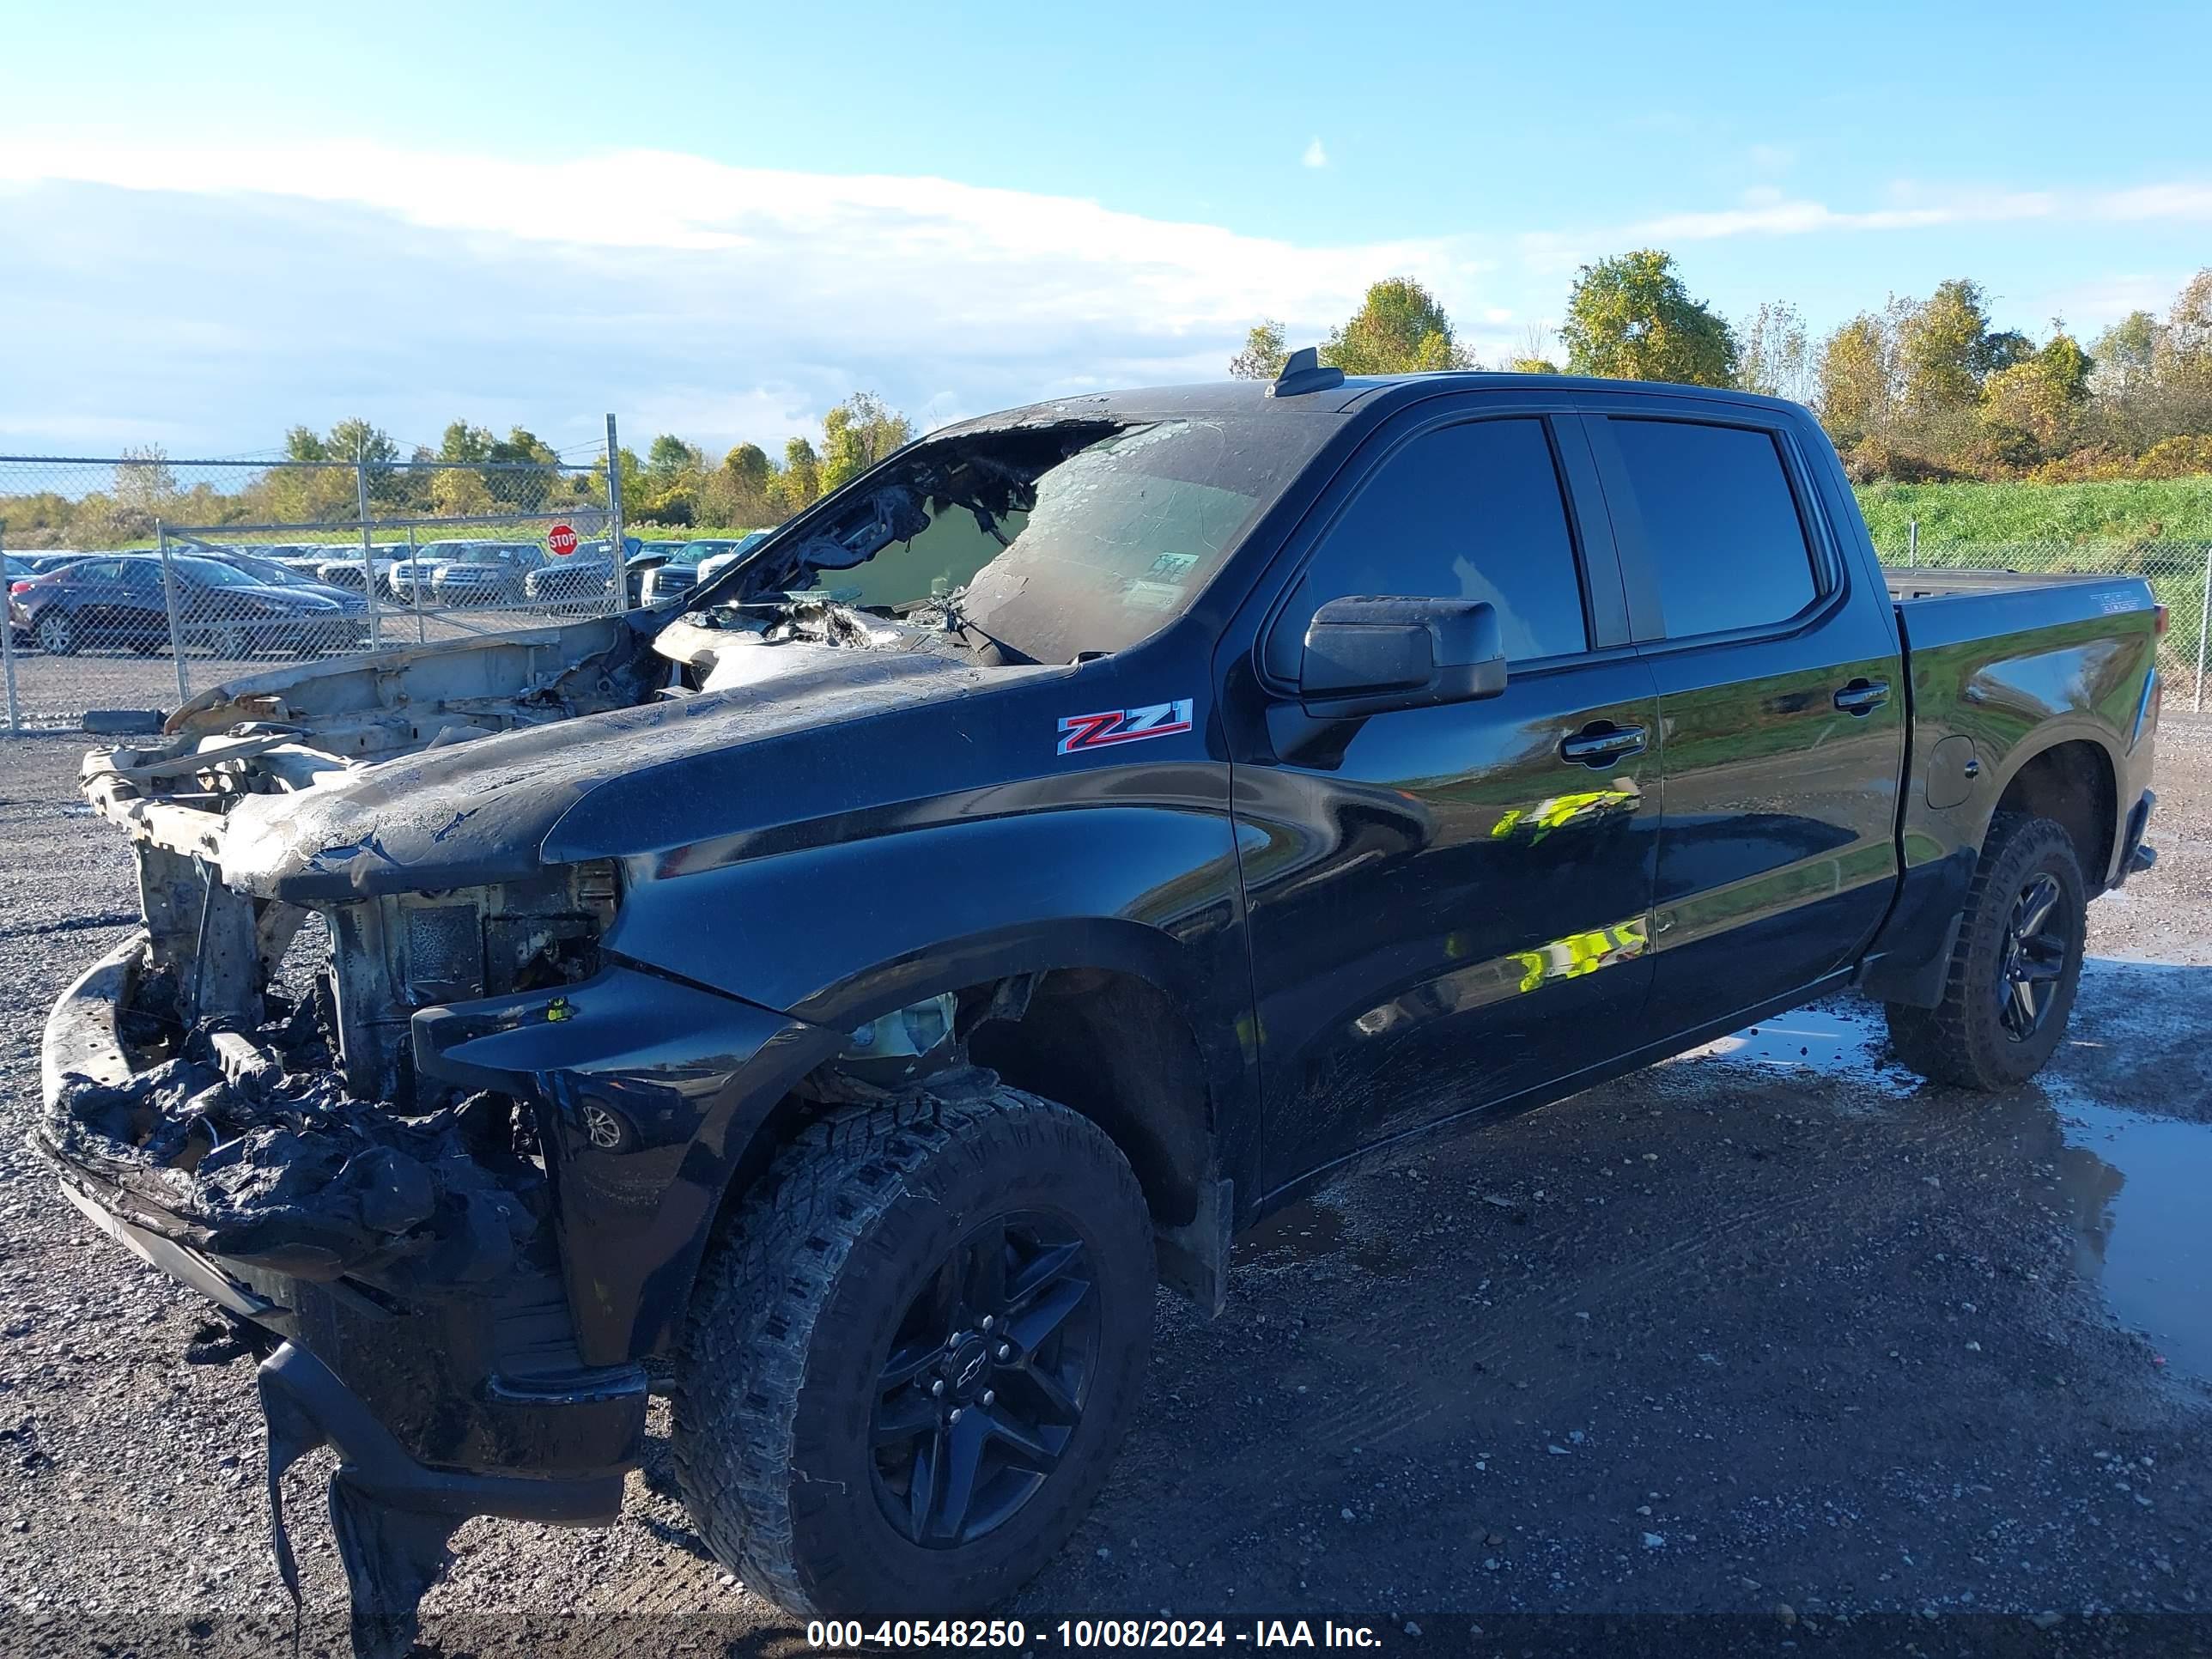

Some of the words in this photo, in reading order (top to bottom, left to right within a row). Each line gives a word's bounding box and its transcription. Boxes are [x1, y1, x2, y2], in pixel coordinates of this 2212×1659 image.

[550, 533, 575, 548] STOP
[2100, 602, 2138, 614] BOSS
[1057, 698, 1193, 756] Z71
